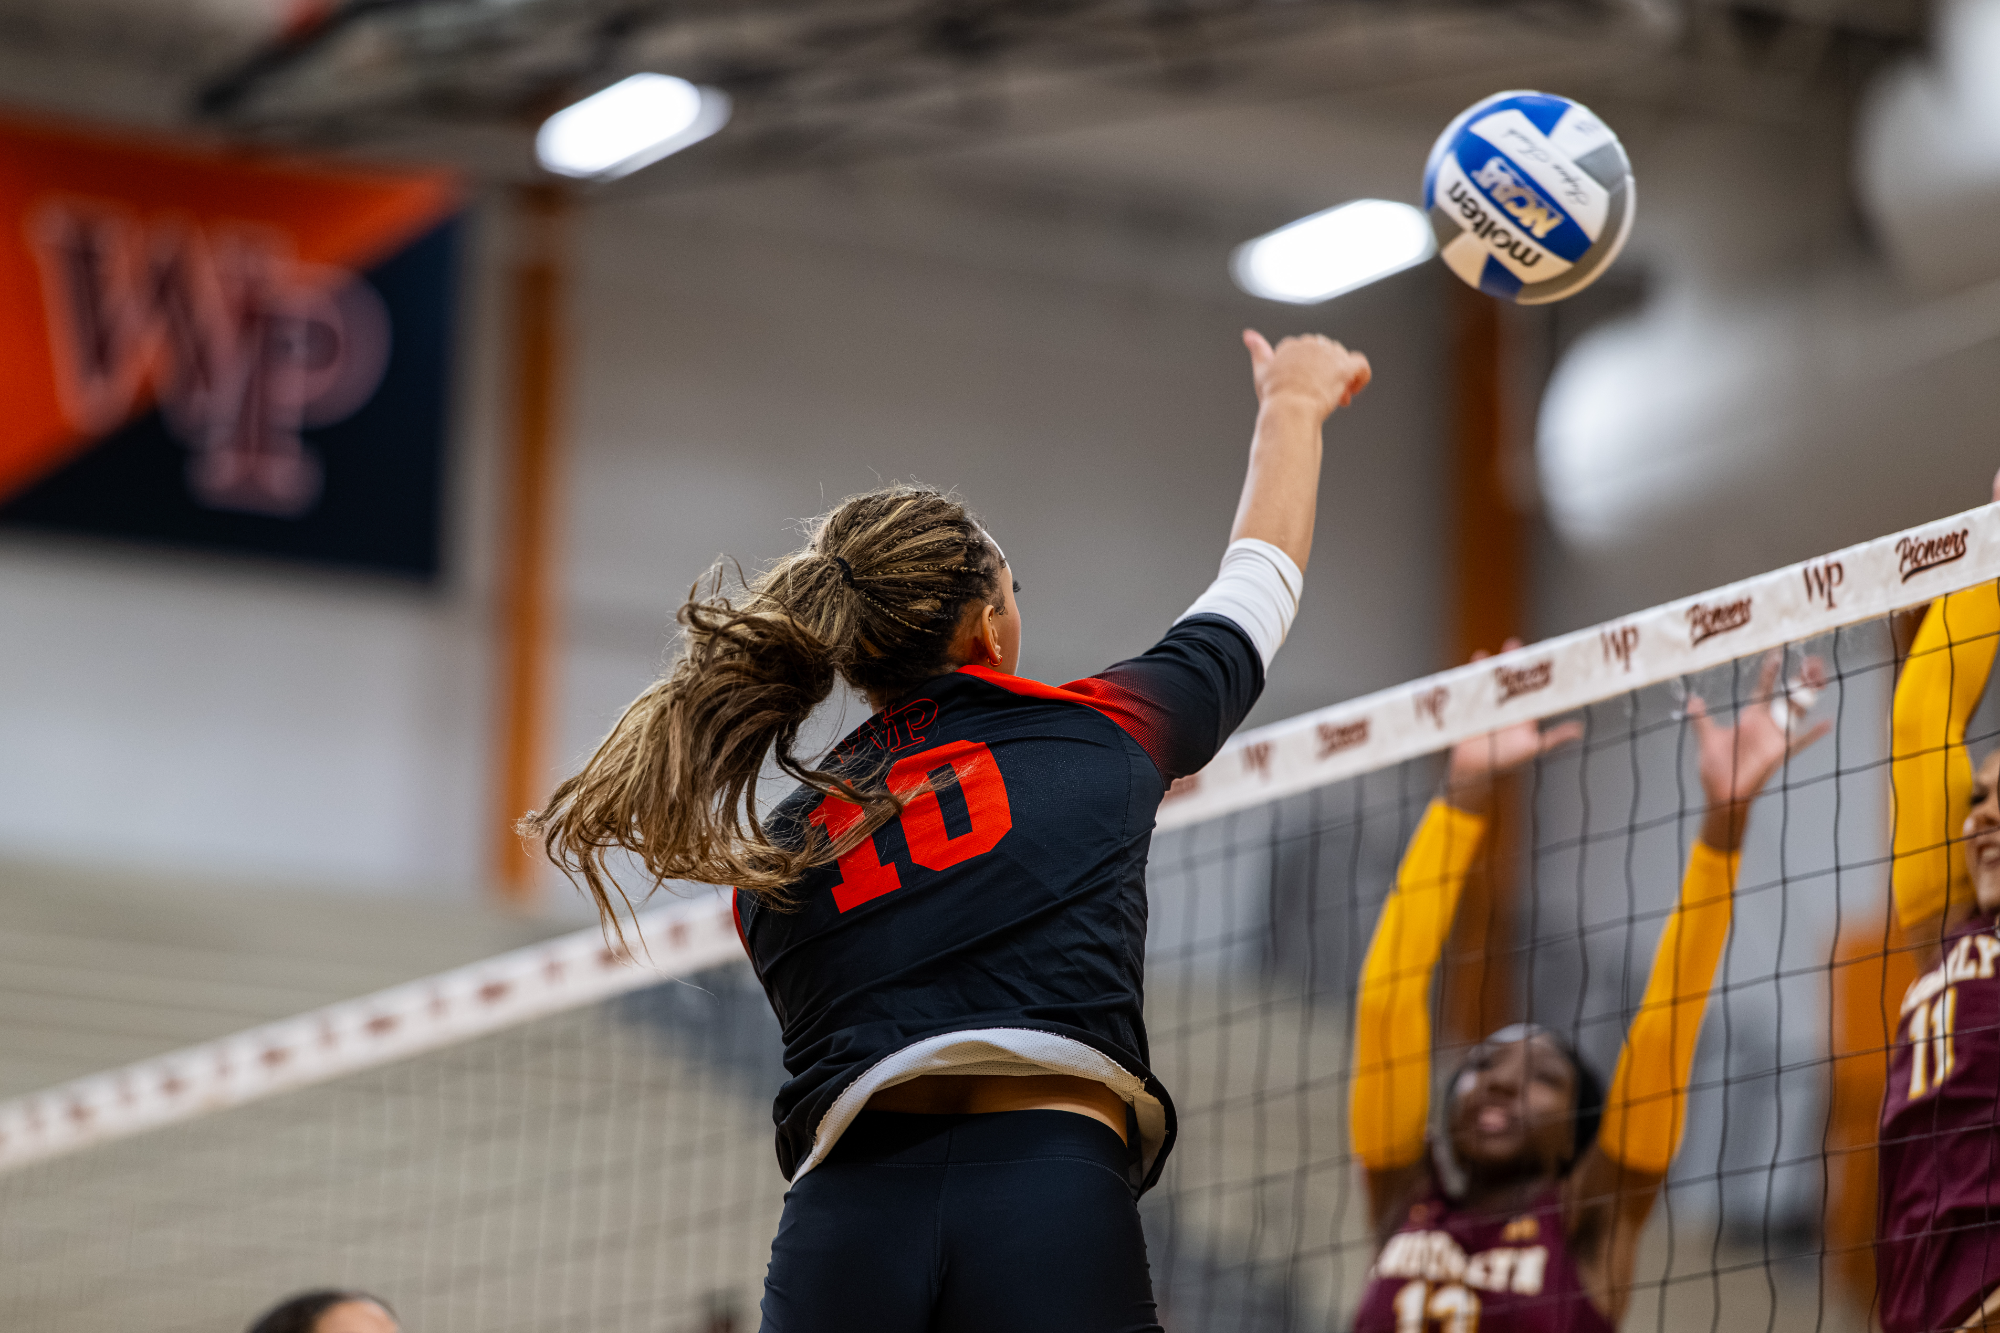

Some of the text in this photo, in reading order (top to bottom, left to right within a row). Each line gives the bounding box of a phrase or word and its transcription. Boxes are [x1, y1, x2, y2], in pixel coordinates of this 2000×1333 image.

[1448, 180, 1543, 268] molten
[1471, 156, 1565, 240] NCAA
[25, 195, 393, 518] WP
[1803, 560, 1845, 611] WP
[1895, 528, 1969, 584] Pioneers
[807, 739, 1013, 914] 10
[1908, 985, 1958, 1101] 11
